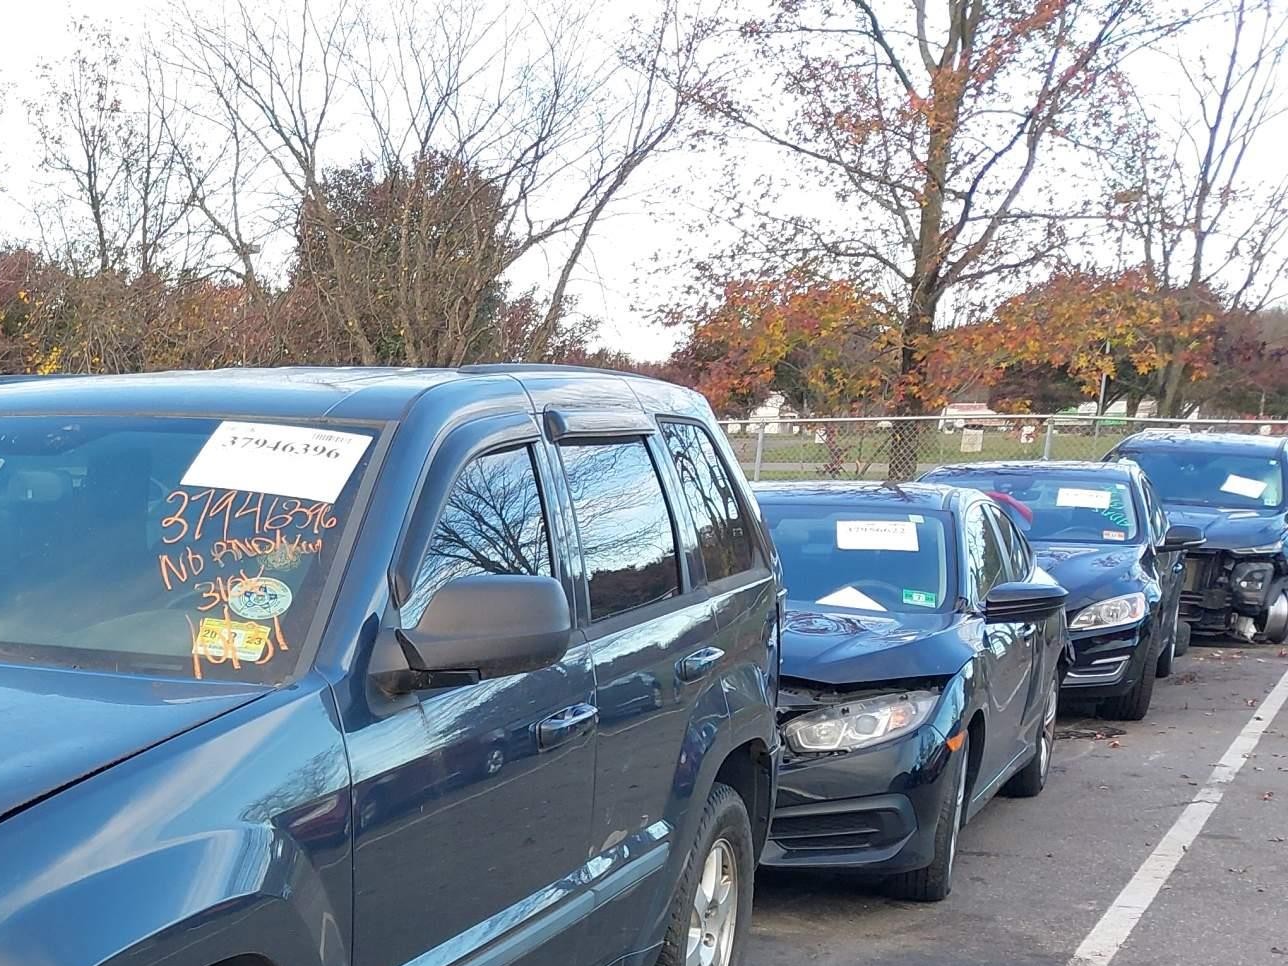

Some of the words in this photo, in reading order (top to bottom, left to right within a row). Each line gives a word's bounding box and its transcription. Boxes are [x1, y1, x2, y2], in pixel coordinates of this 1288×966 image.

[220, 435, 342, 460] 37946396
[161, 488, 338, 544] 37946396
[245, 635, 263, 646] 23
